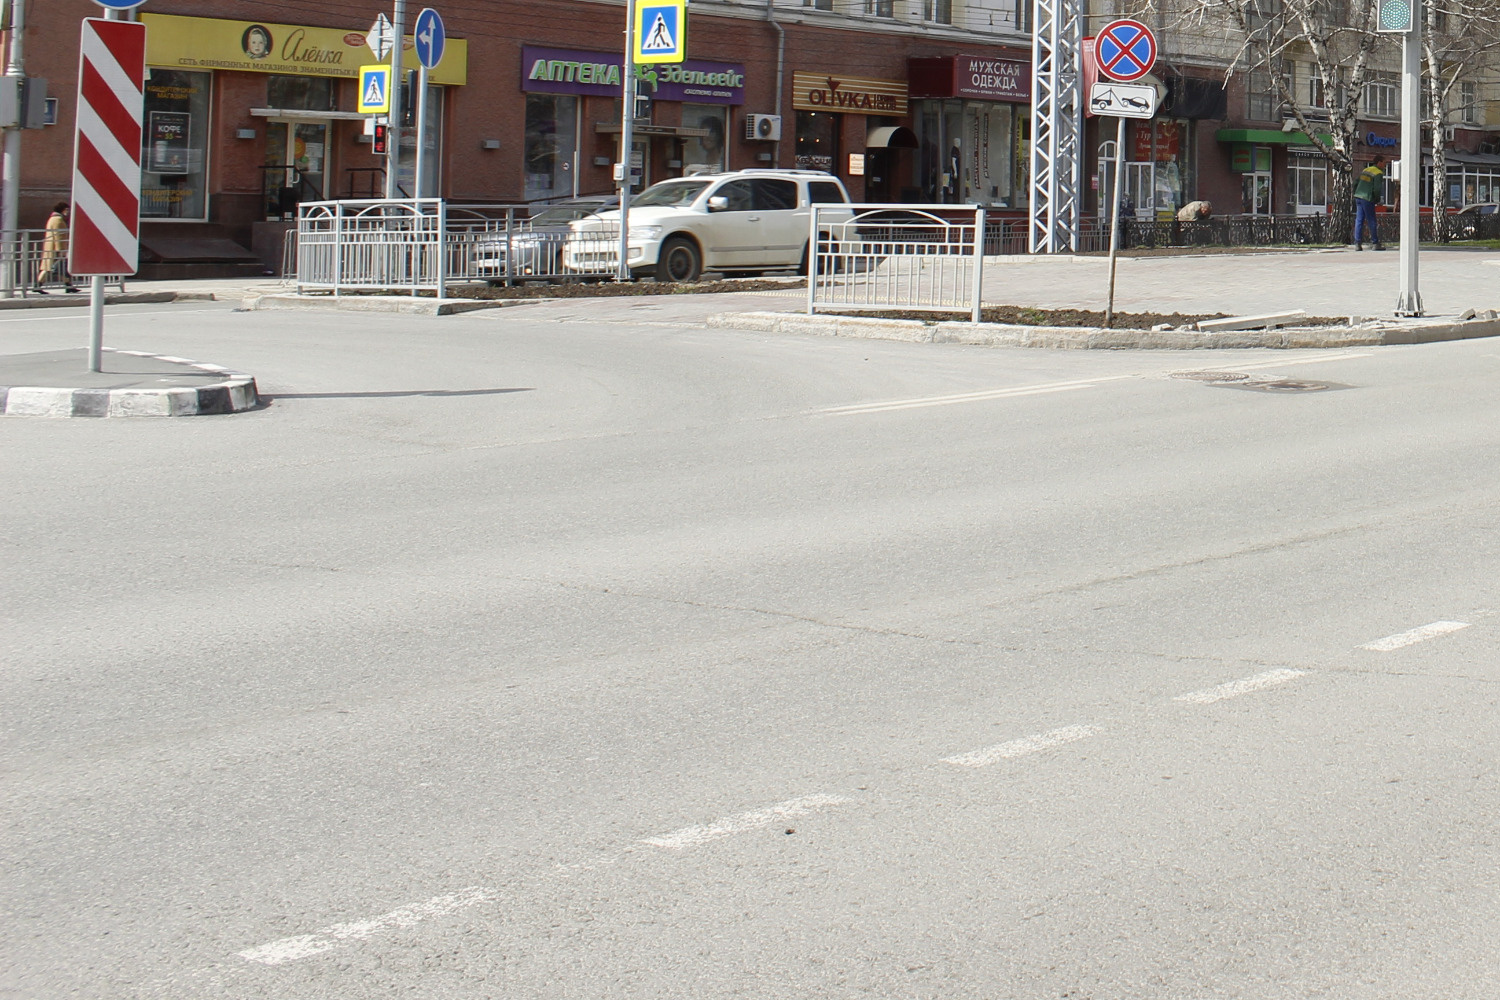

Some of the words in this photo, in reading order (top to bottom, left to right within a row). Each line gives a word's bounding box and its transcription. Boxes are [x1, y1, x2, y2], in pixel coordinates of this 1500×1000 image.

[281, 28, 343, 64] Алёнка
[178, 58, 197, 66] СЕТЬ
[199, 59, 251, 69] ФИРМЕННЫХ
[252, 62, 298, 72] МАГАЗИНОВ
[299, 66, 351, 76] ЗНАМЕНИТЫХ
[529, 59, 620, 86] АПТЕКА
[658, 64, 744, 88] Эдельвейс
[968, 60, 1020, 76] МУЖСКАЯ
[971, 73, 1018, 90] ОДЕЖДА
[808, 81, 874, 110] OLIVKA
[157, 125, 181, 133] КОФЕ
